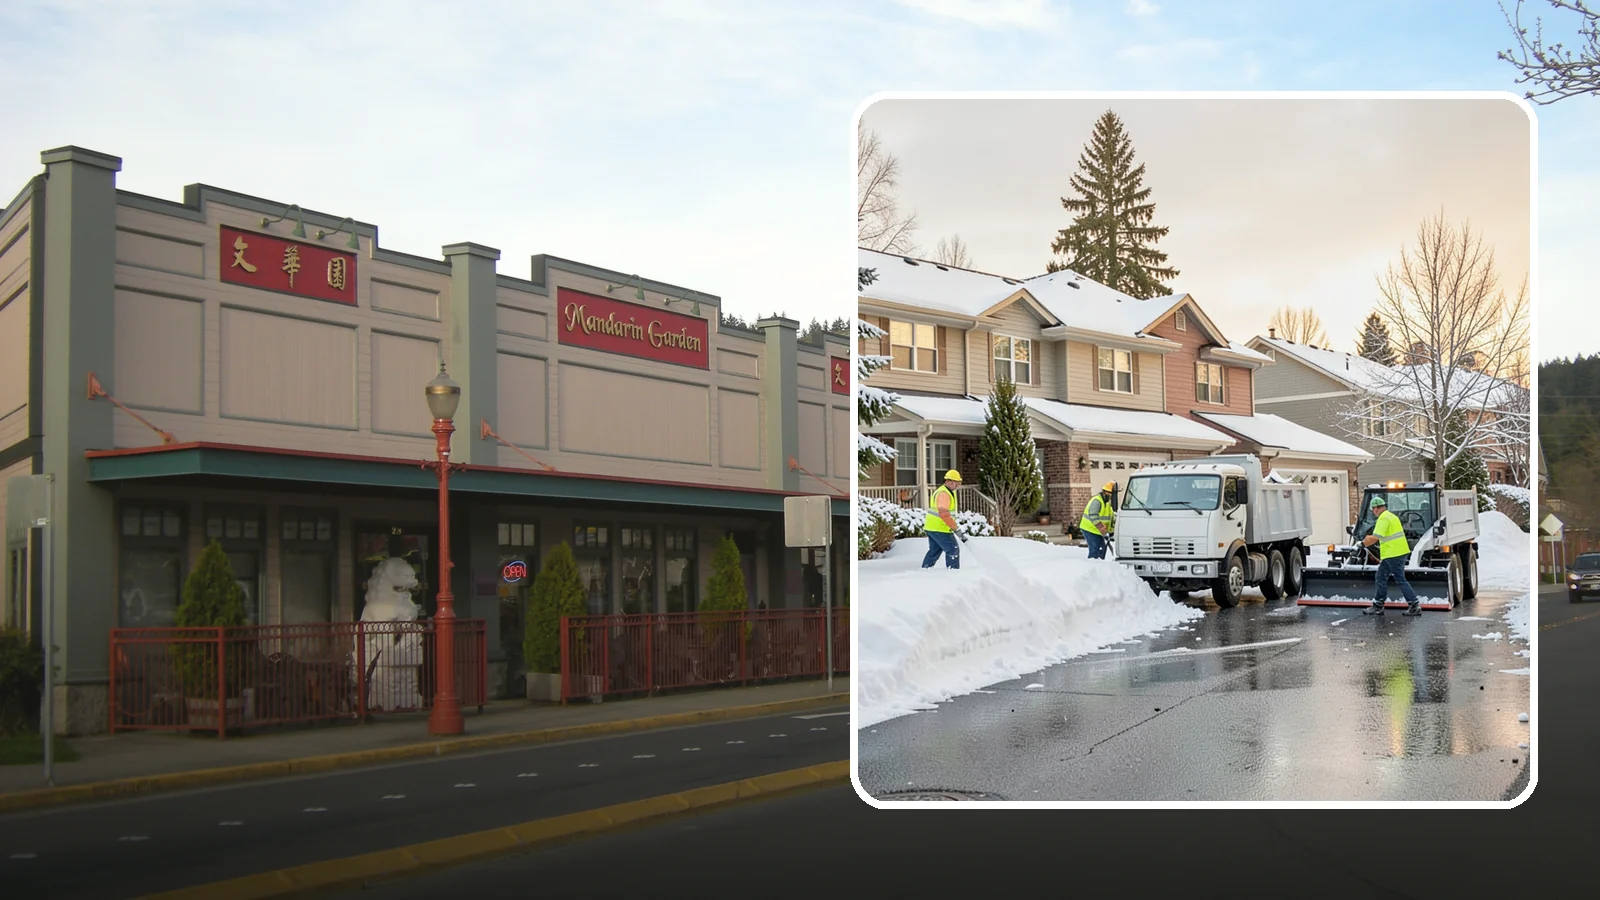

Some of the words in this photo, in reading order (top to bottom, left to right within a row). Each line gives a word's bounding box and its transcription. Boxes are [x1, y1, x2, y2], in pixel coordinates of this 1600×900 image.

[564, 302, 643, 340] Mandarin
[648, 320, 701, 352] Garden
[503, 565, 527, 578] OPEN
